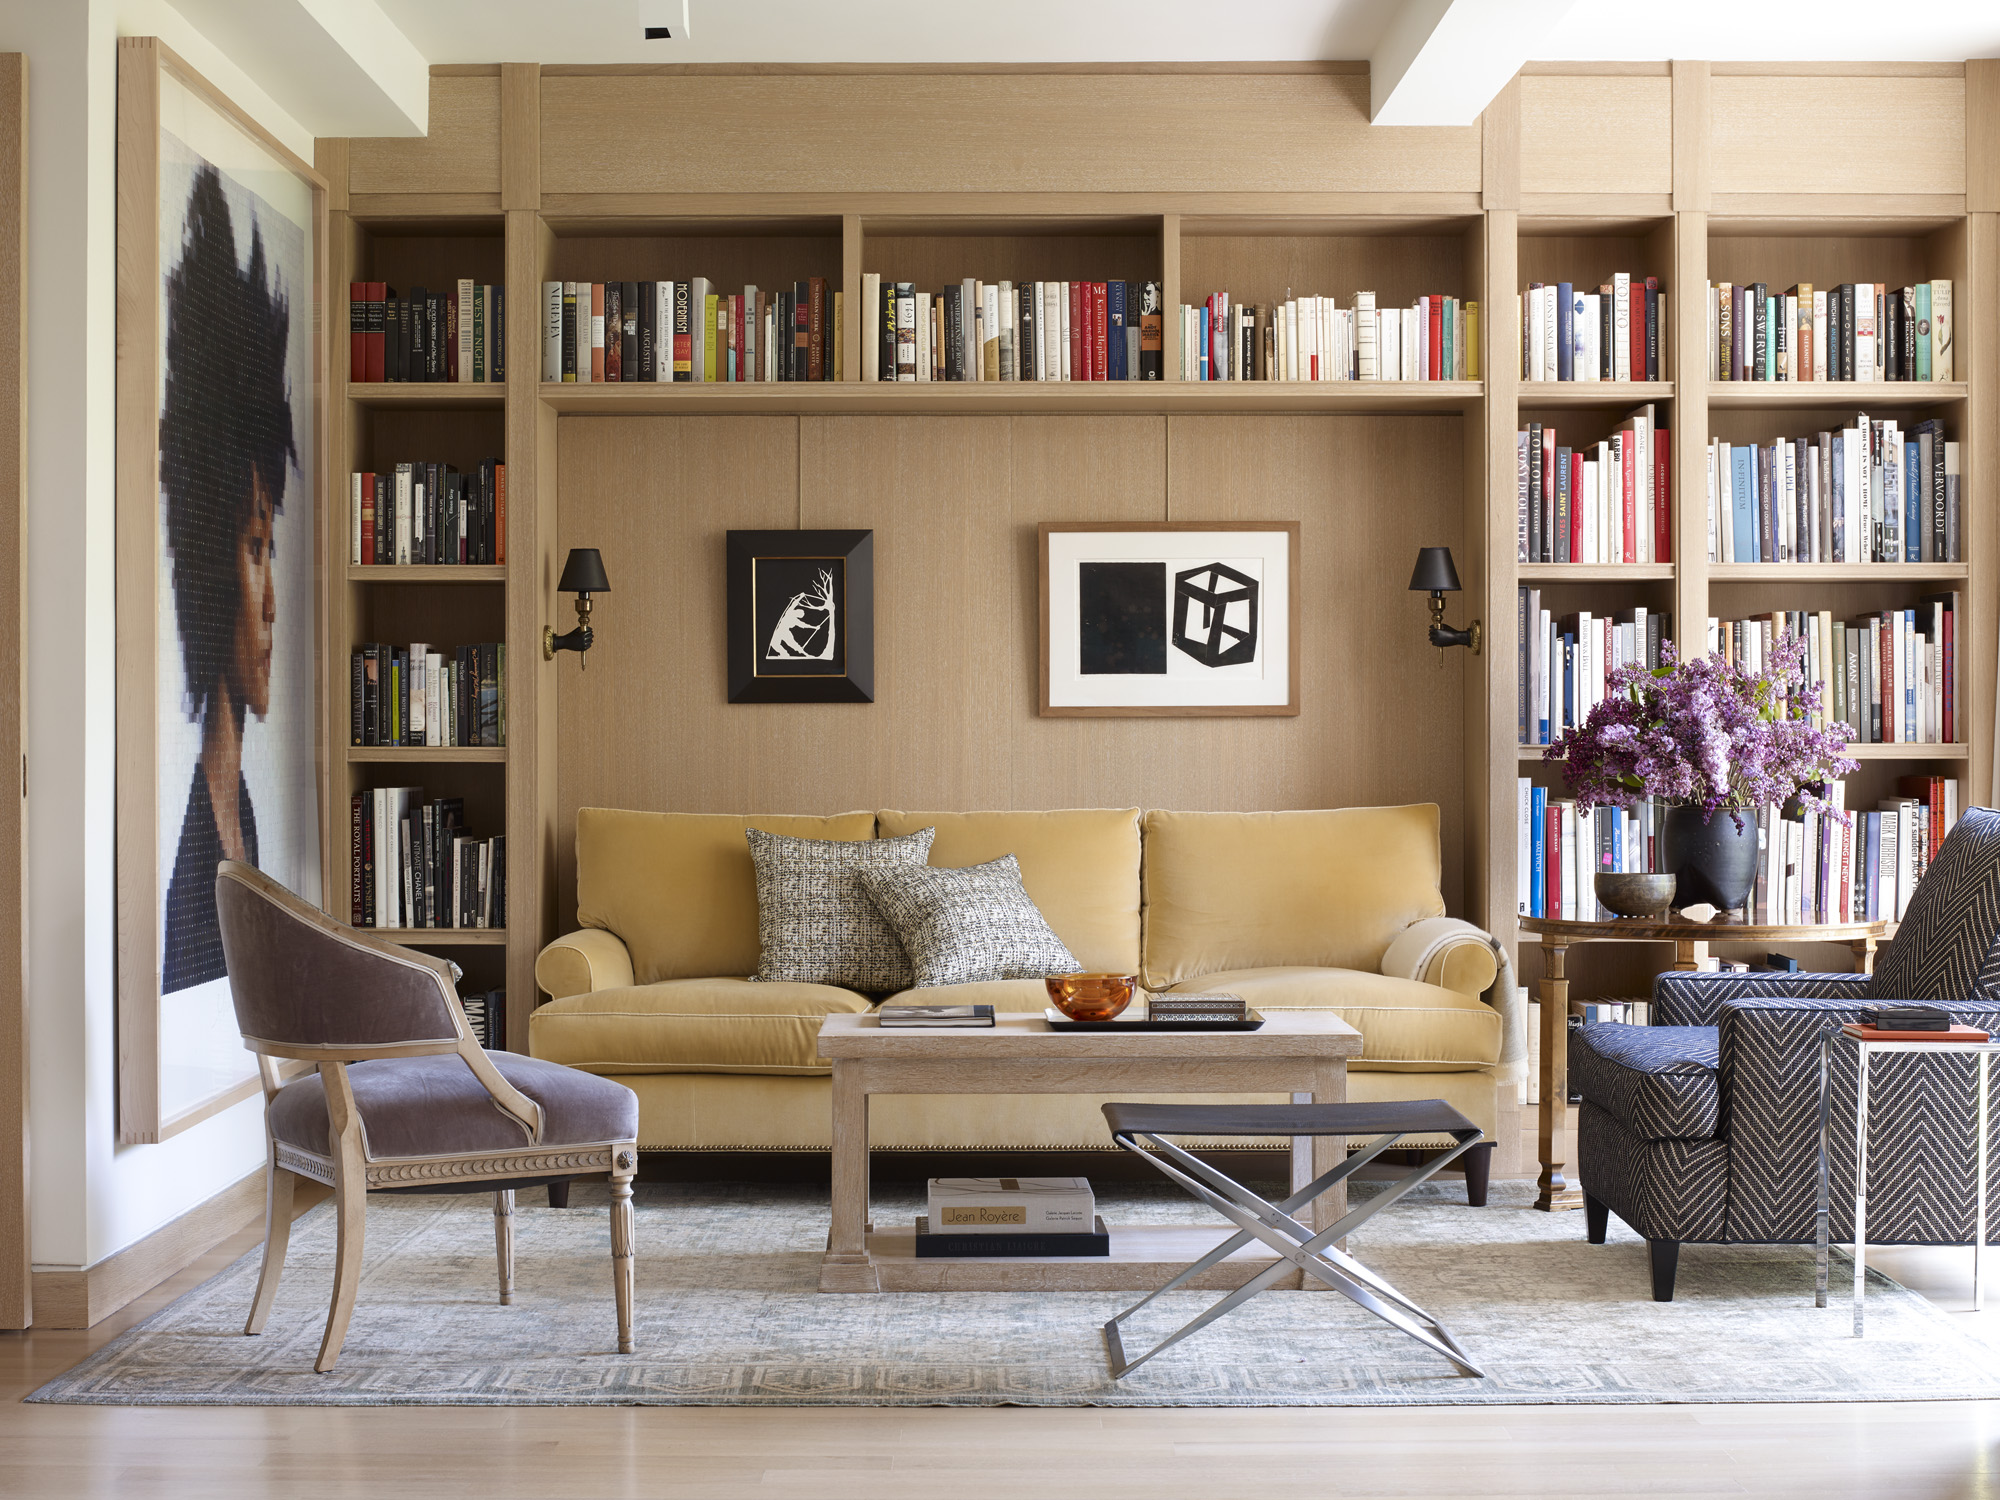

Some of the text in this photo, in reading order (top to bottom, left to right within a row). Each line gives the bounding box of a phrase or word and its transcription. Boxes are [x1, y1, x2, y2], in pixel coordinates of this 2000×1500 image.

[676, 283, 688, 333] MODERNISM
[1616, 277, 1628, 329] POLPO
[1721, 305, 1731, 337] SONS
[1756, 315, 1766, 364] SWERVE
[1531, 429, 1541, 489] LOULOU
[1935, 462, 1944, 535] VERVOORDT
[353, 657, 362, 735] EDMUND WHITE
[1912, 812, 1919, 820] of
[1881, 814, 1896, 878] MARK MORRISROE
[947, 1208, 1020, 1224] Jean Royère
